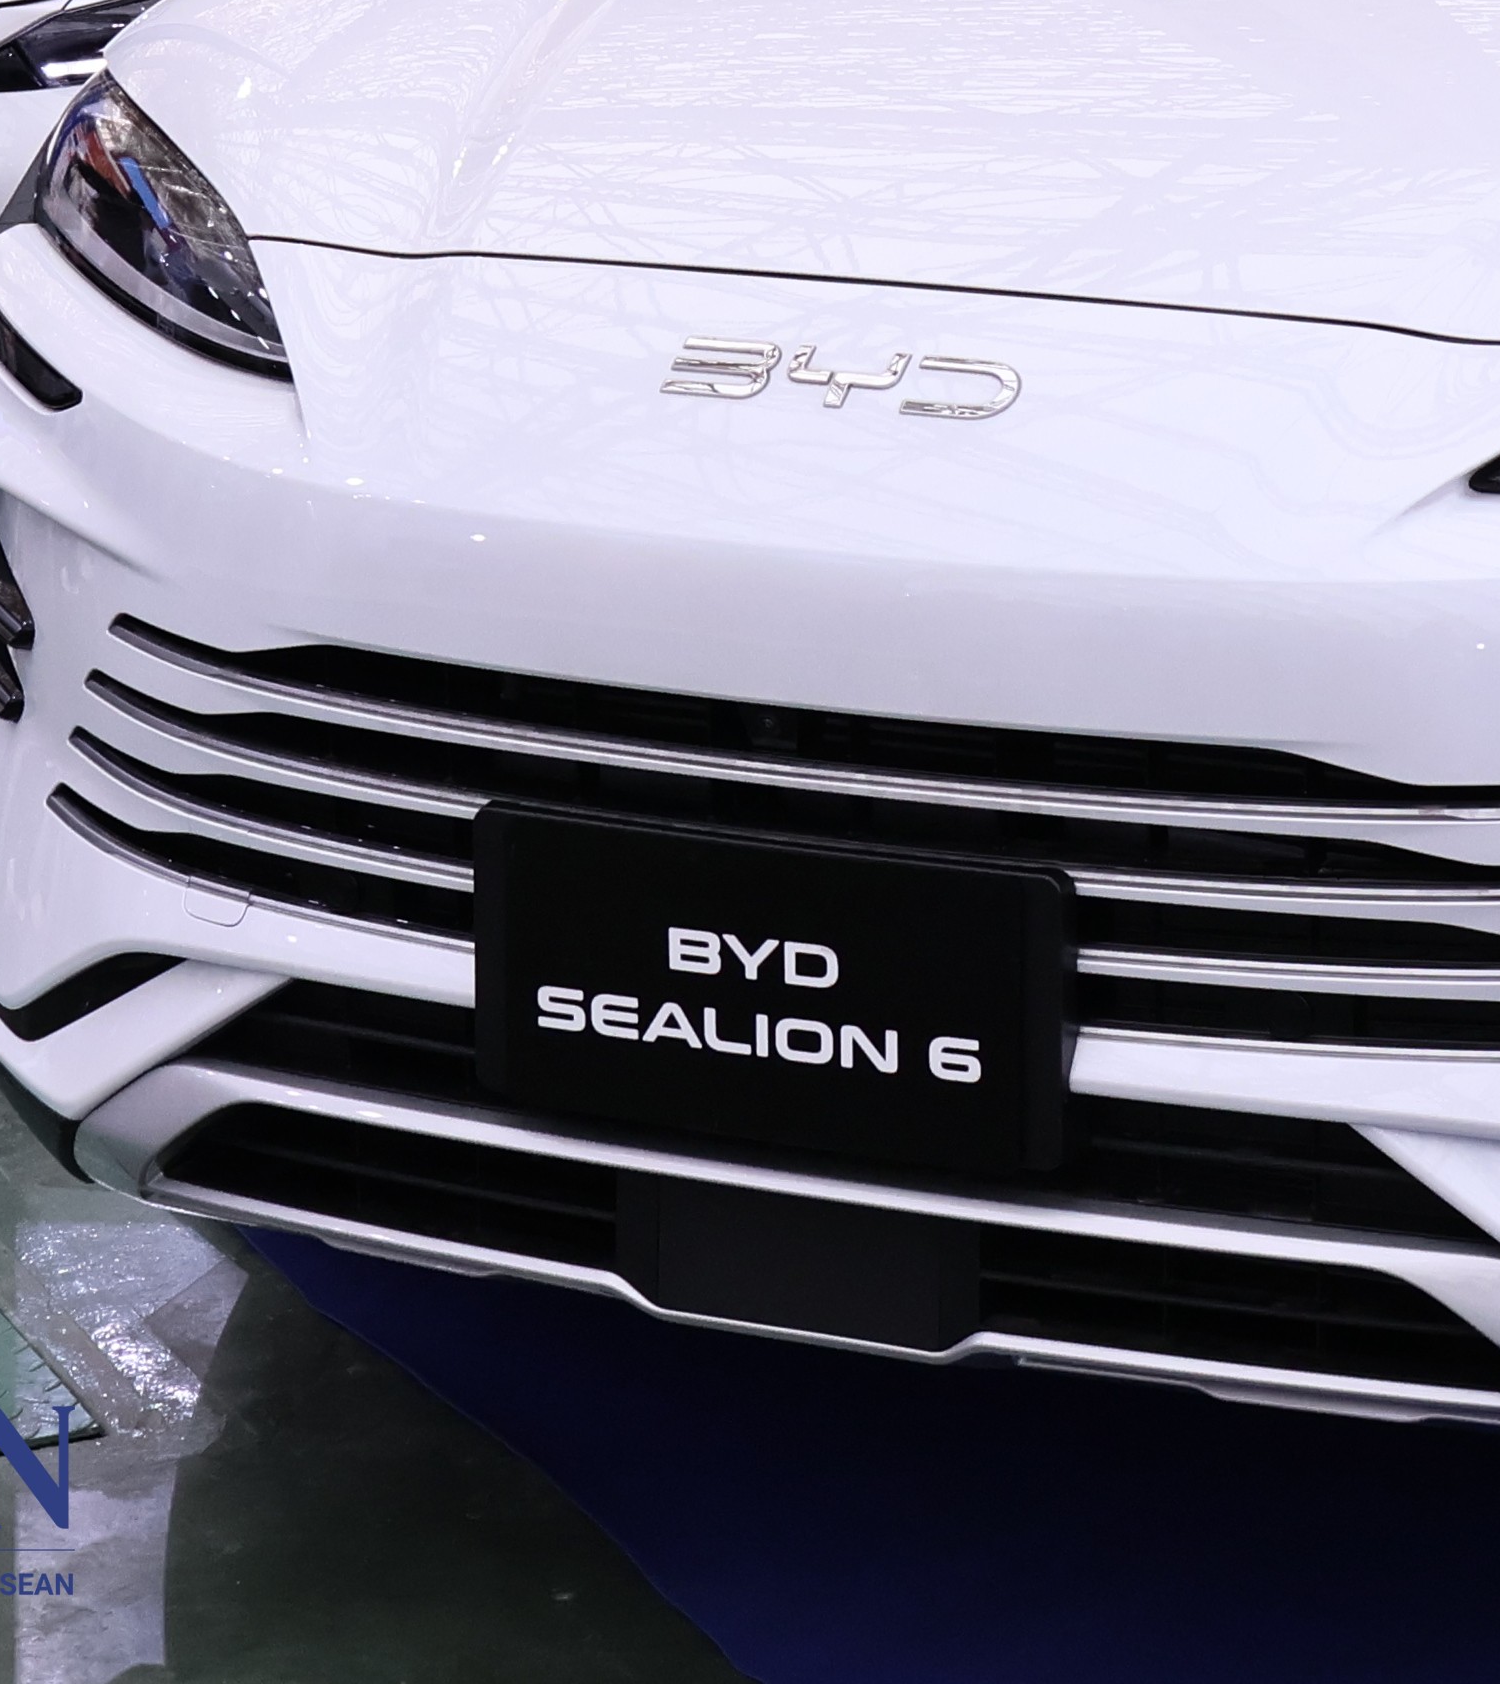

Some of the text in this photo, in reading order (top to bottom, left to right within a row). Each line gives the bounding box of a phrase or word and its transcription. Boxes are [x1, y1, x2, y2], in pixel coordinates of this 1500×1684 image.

[660, 335, 1021, 420] BYD
[668, 926, 839, 989] BYD
[537, 985, 981, 1083] SEALION 6
